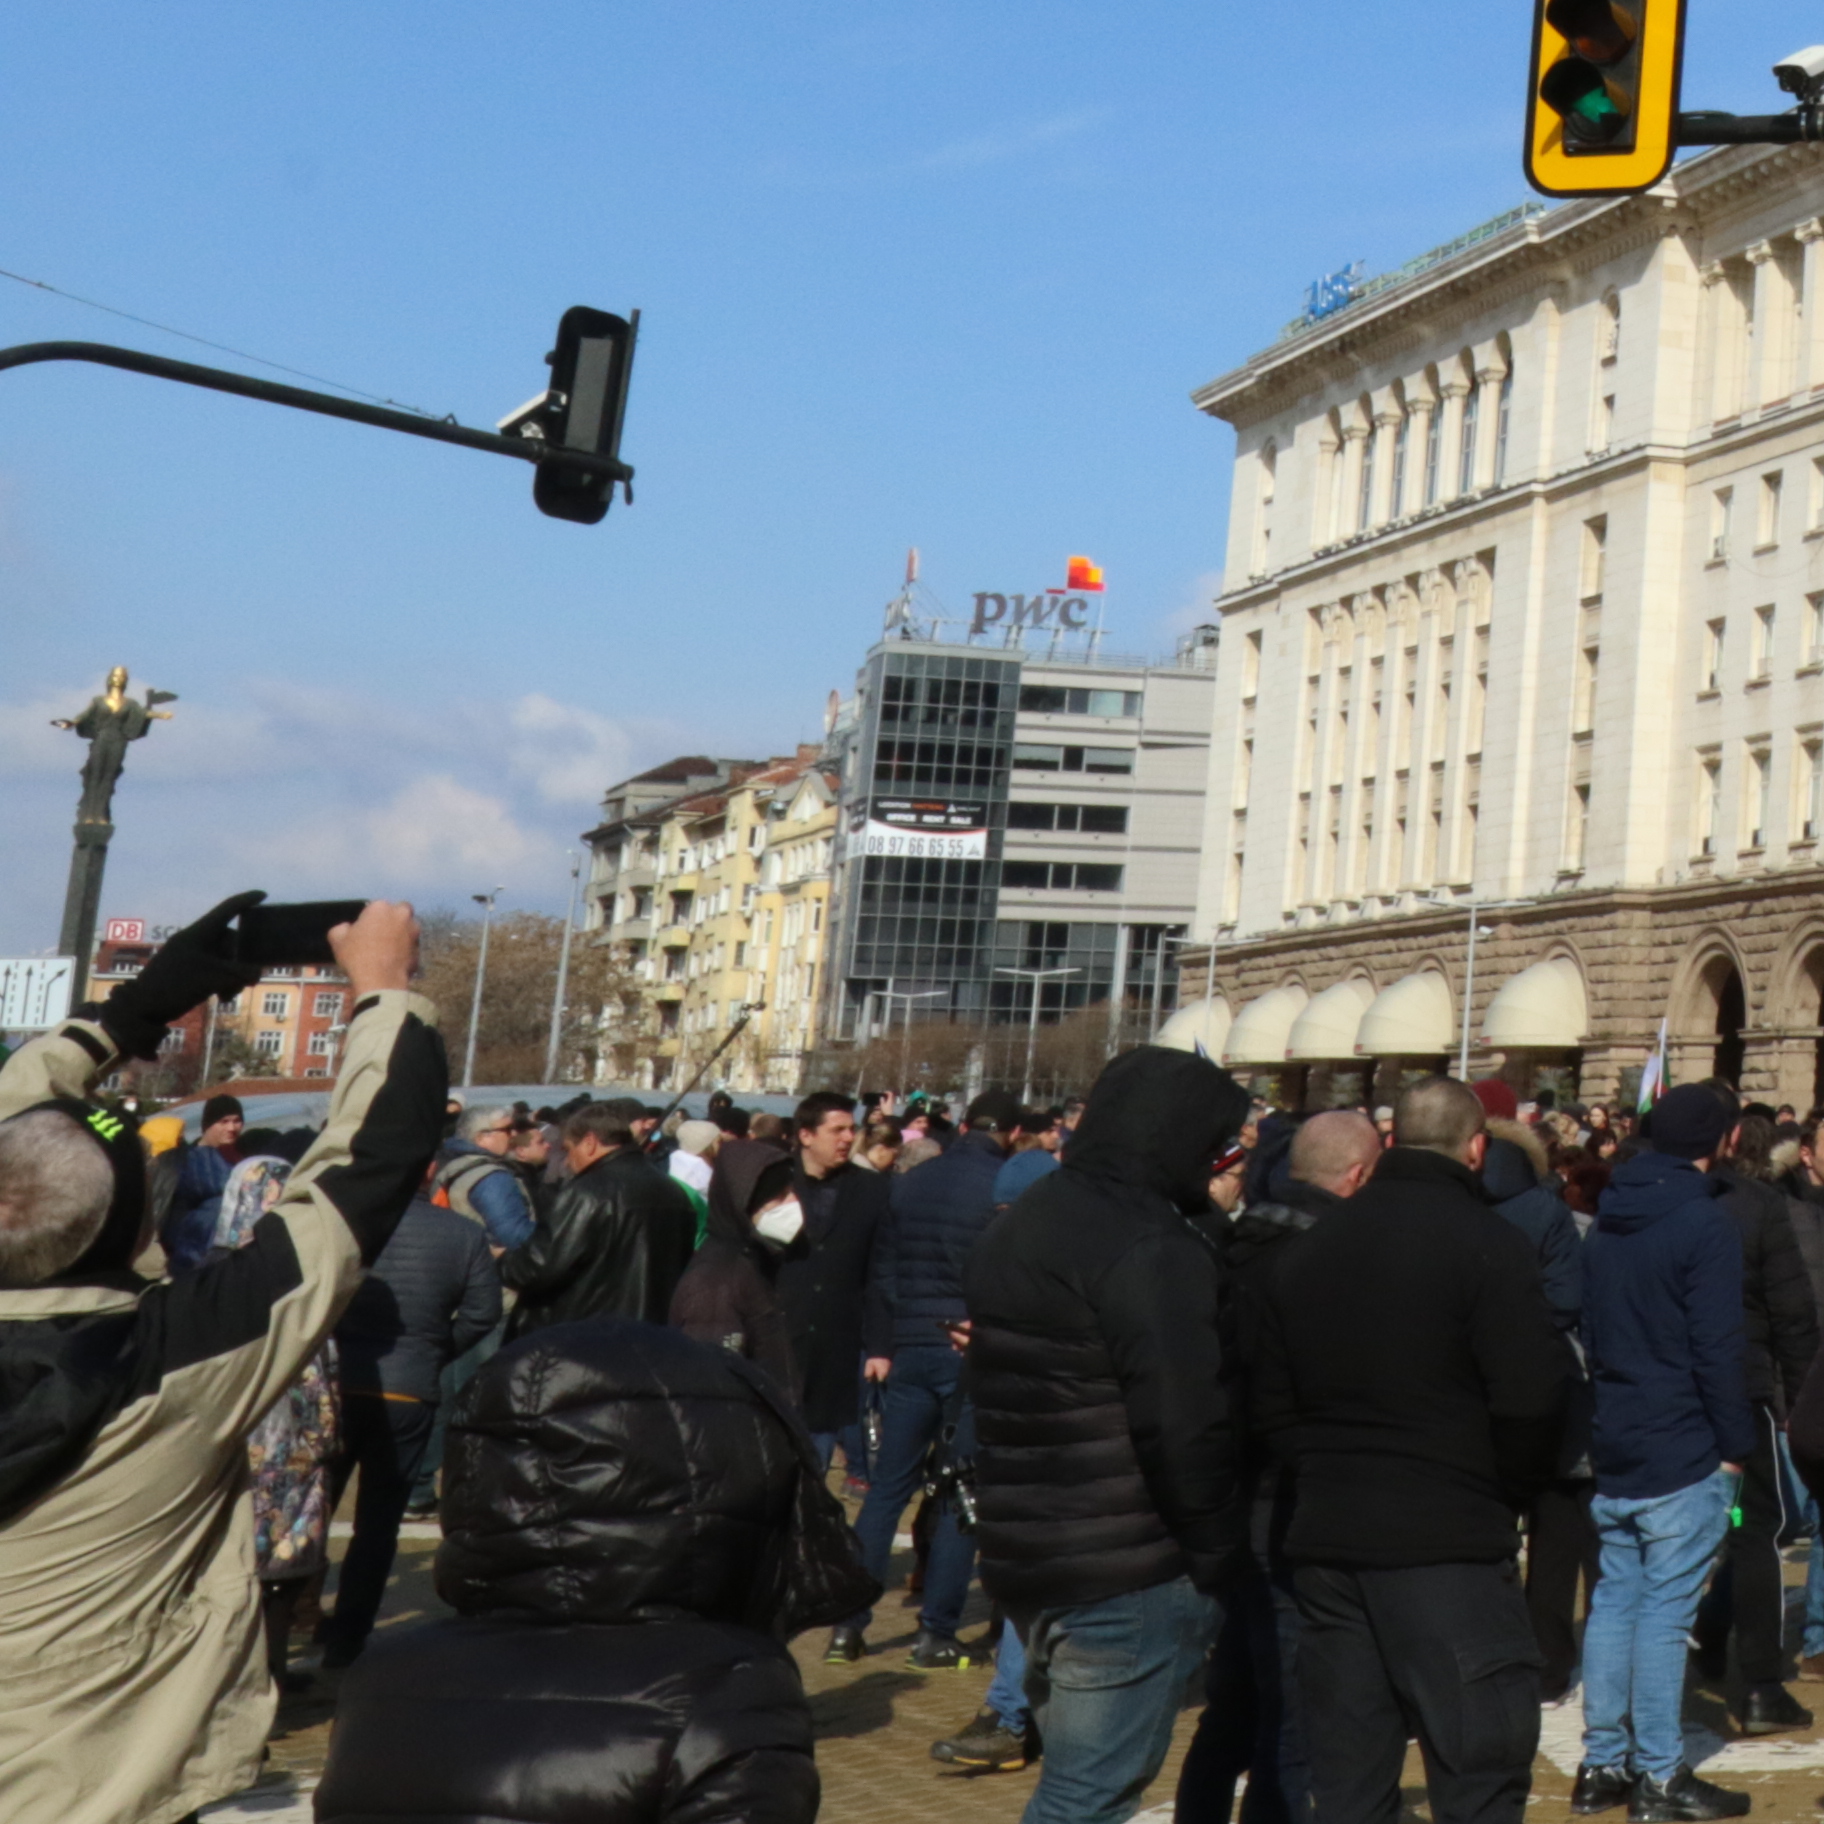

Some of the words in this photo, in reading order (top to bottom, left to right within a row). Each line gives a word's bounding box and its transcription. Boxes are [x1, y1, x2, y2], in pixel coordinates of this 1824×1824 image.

[972, 591, 1088, 635] pwc
[868, 835, 885, 854] 08
[888, 836, 905, 855] 97
[908, 837, 925, 856] 66
[928, 838, 945, 856] 65
[948, 839, 964, 857] 55
[111, 922, 140, 940] DB
